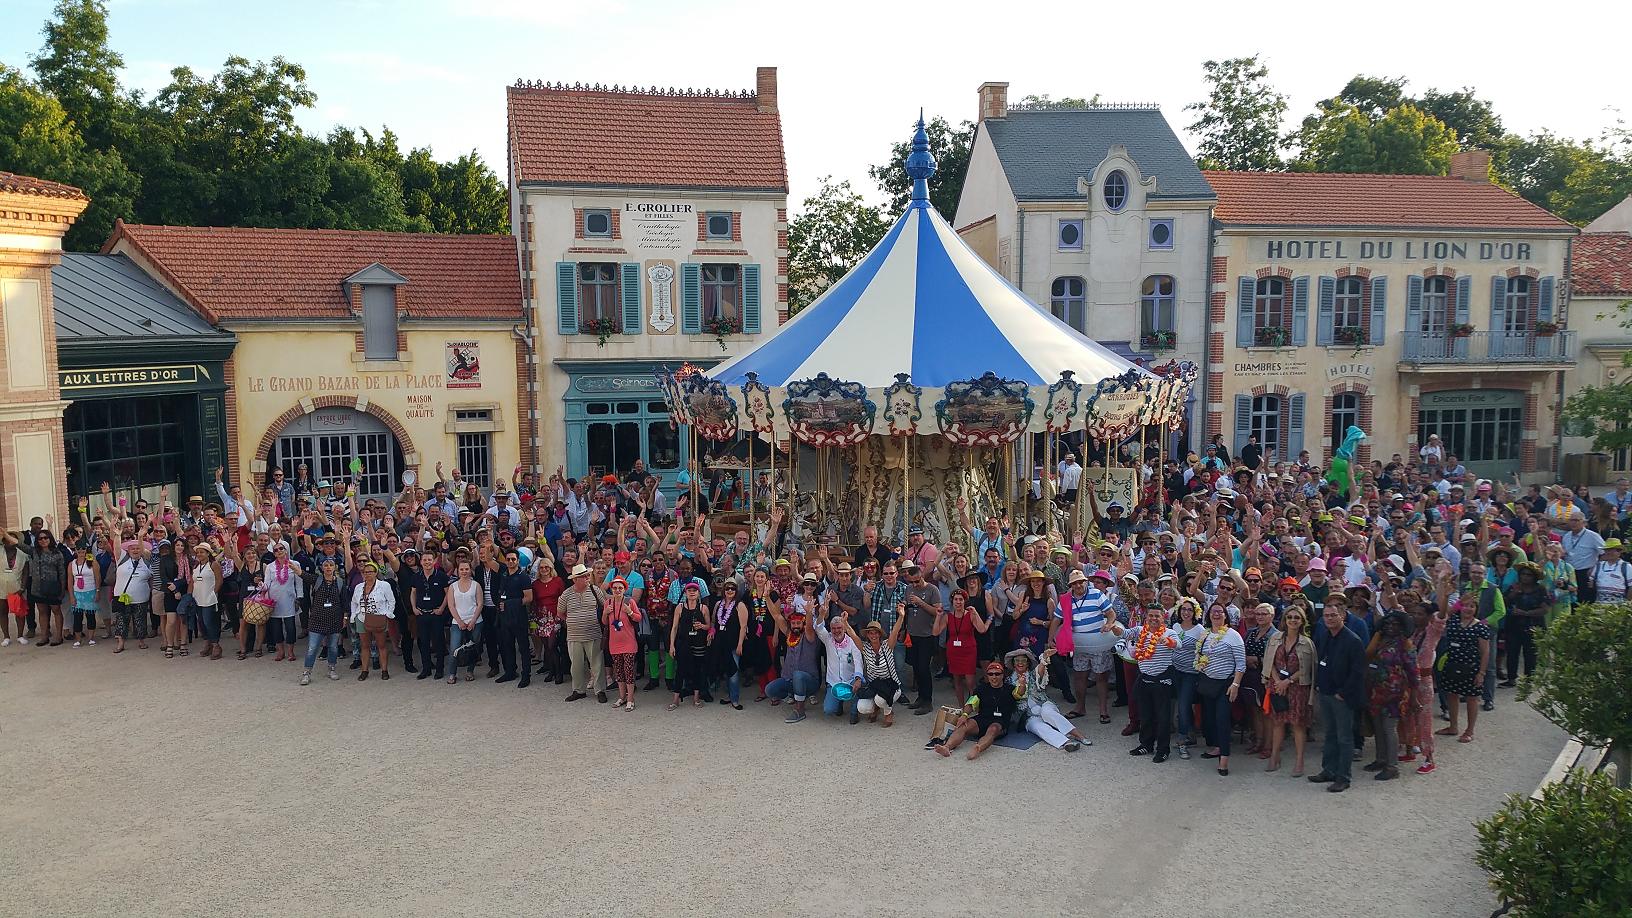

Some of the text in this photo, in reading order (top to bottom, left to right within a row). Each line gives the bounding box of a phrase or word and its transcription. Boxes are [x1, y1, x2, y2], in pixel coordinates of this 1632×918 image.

[625, 203, 692, 213] E.GROLIER
[1267, 240, 1531, 260] HOTEL DU LION D'OR
[1234, 362, 1282, 371] CHAMBRES
[1330, 364, 1370, 376] HOTEL
[64, 370, 178, 385] AUX LETTRES D'OR
[365, 375, 381, 390] DE
[385, 375, 401, 389] LA
[407, 394, 433, 403] MAISON
